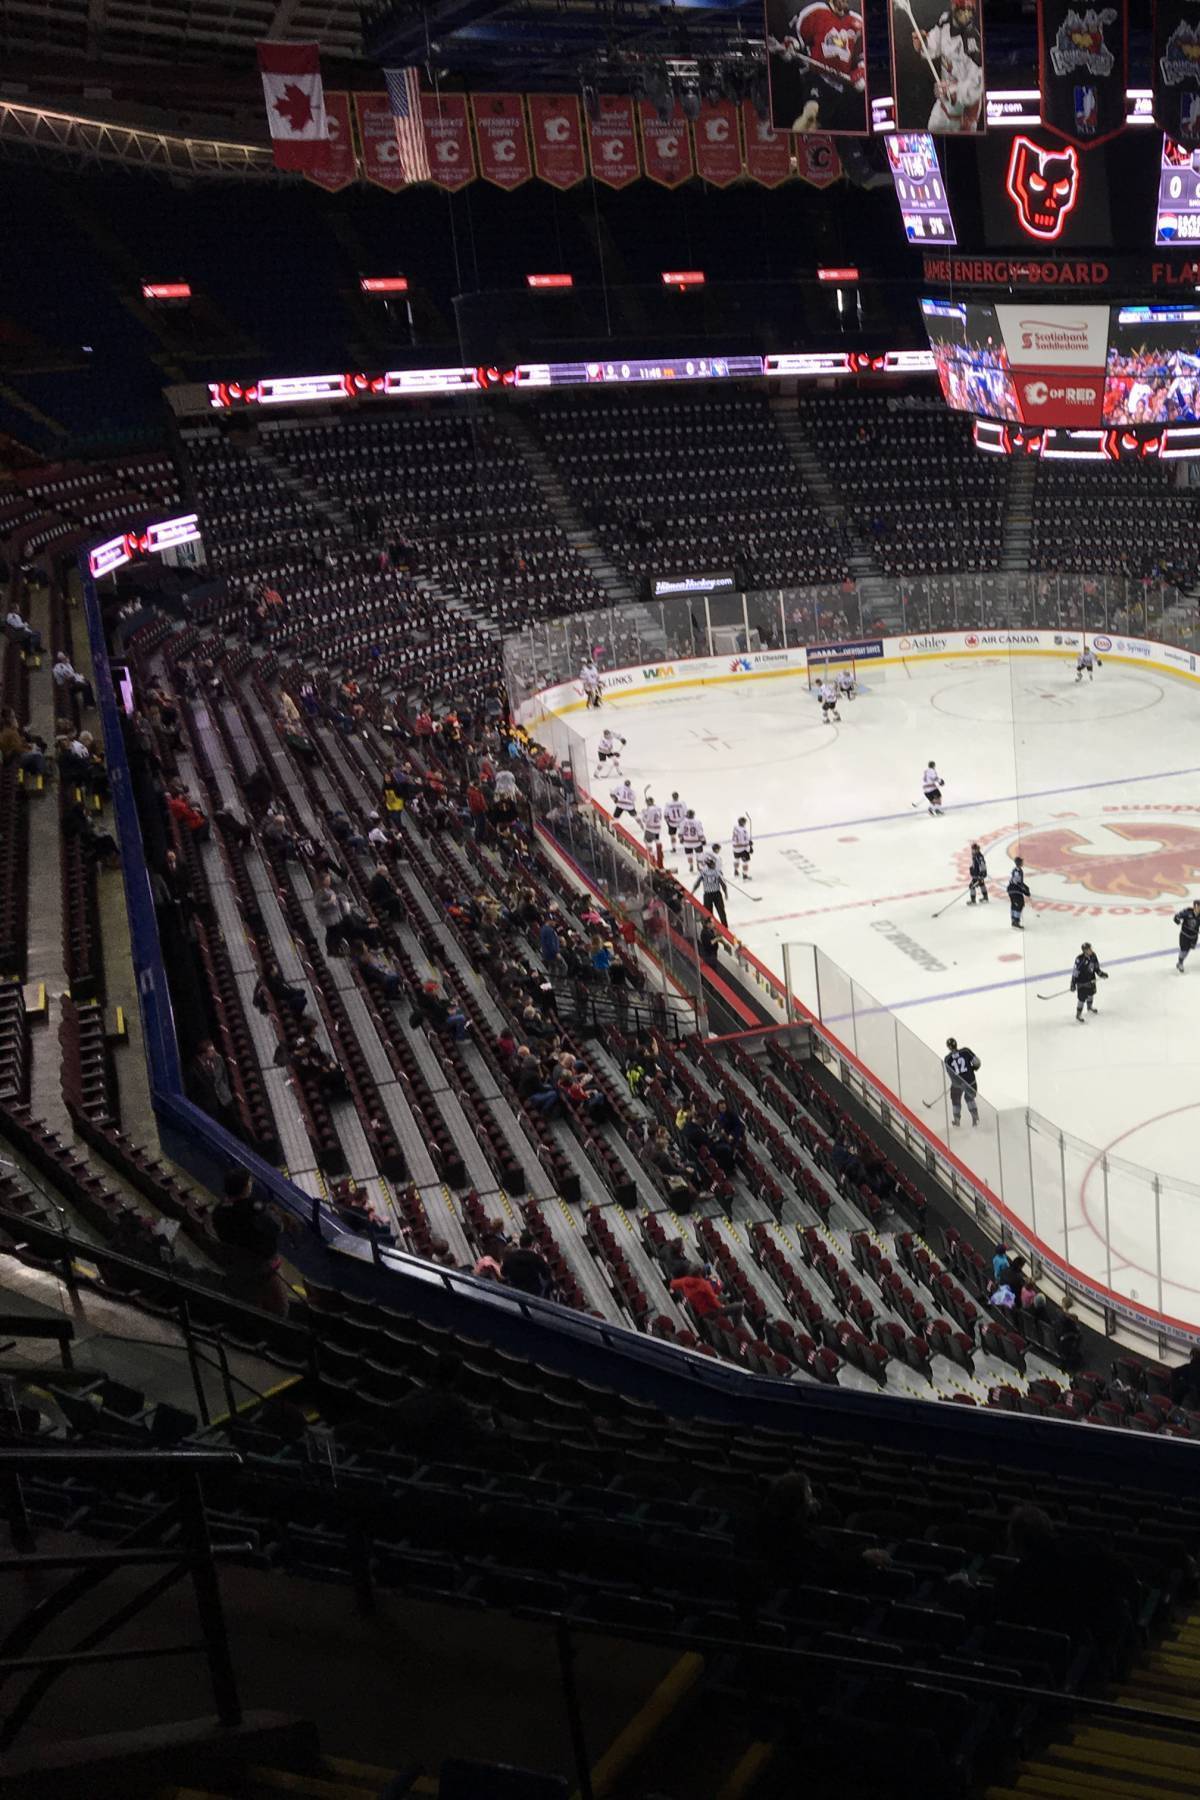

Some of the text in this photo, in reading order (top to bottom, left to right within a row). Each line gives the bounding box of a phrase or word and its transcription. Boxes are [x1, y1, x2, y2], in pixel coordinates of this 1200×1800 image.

[1169, 175, 1182, 199] 0
[1034, 332, 1089, 343] Scotiabank
[1035, 341, 1090, 351] Saddledome
[1065, 387, 1097, 401] RED
[912, 637, 948, 651] Ashley
[981, 634, 1040, 645] AIR CANADA
[950, 1056, 968, 1075] 12
